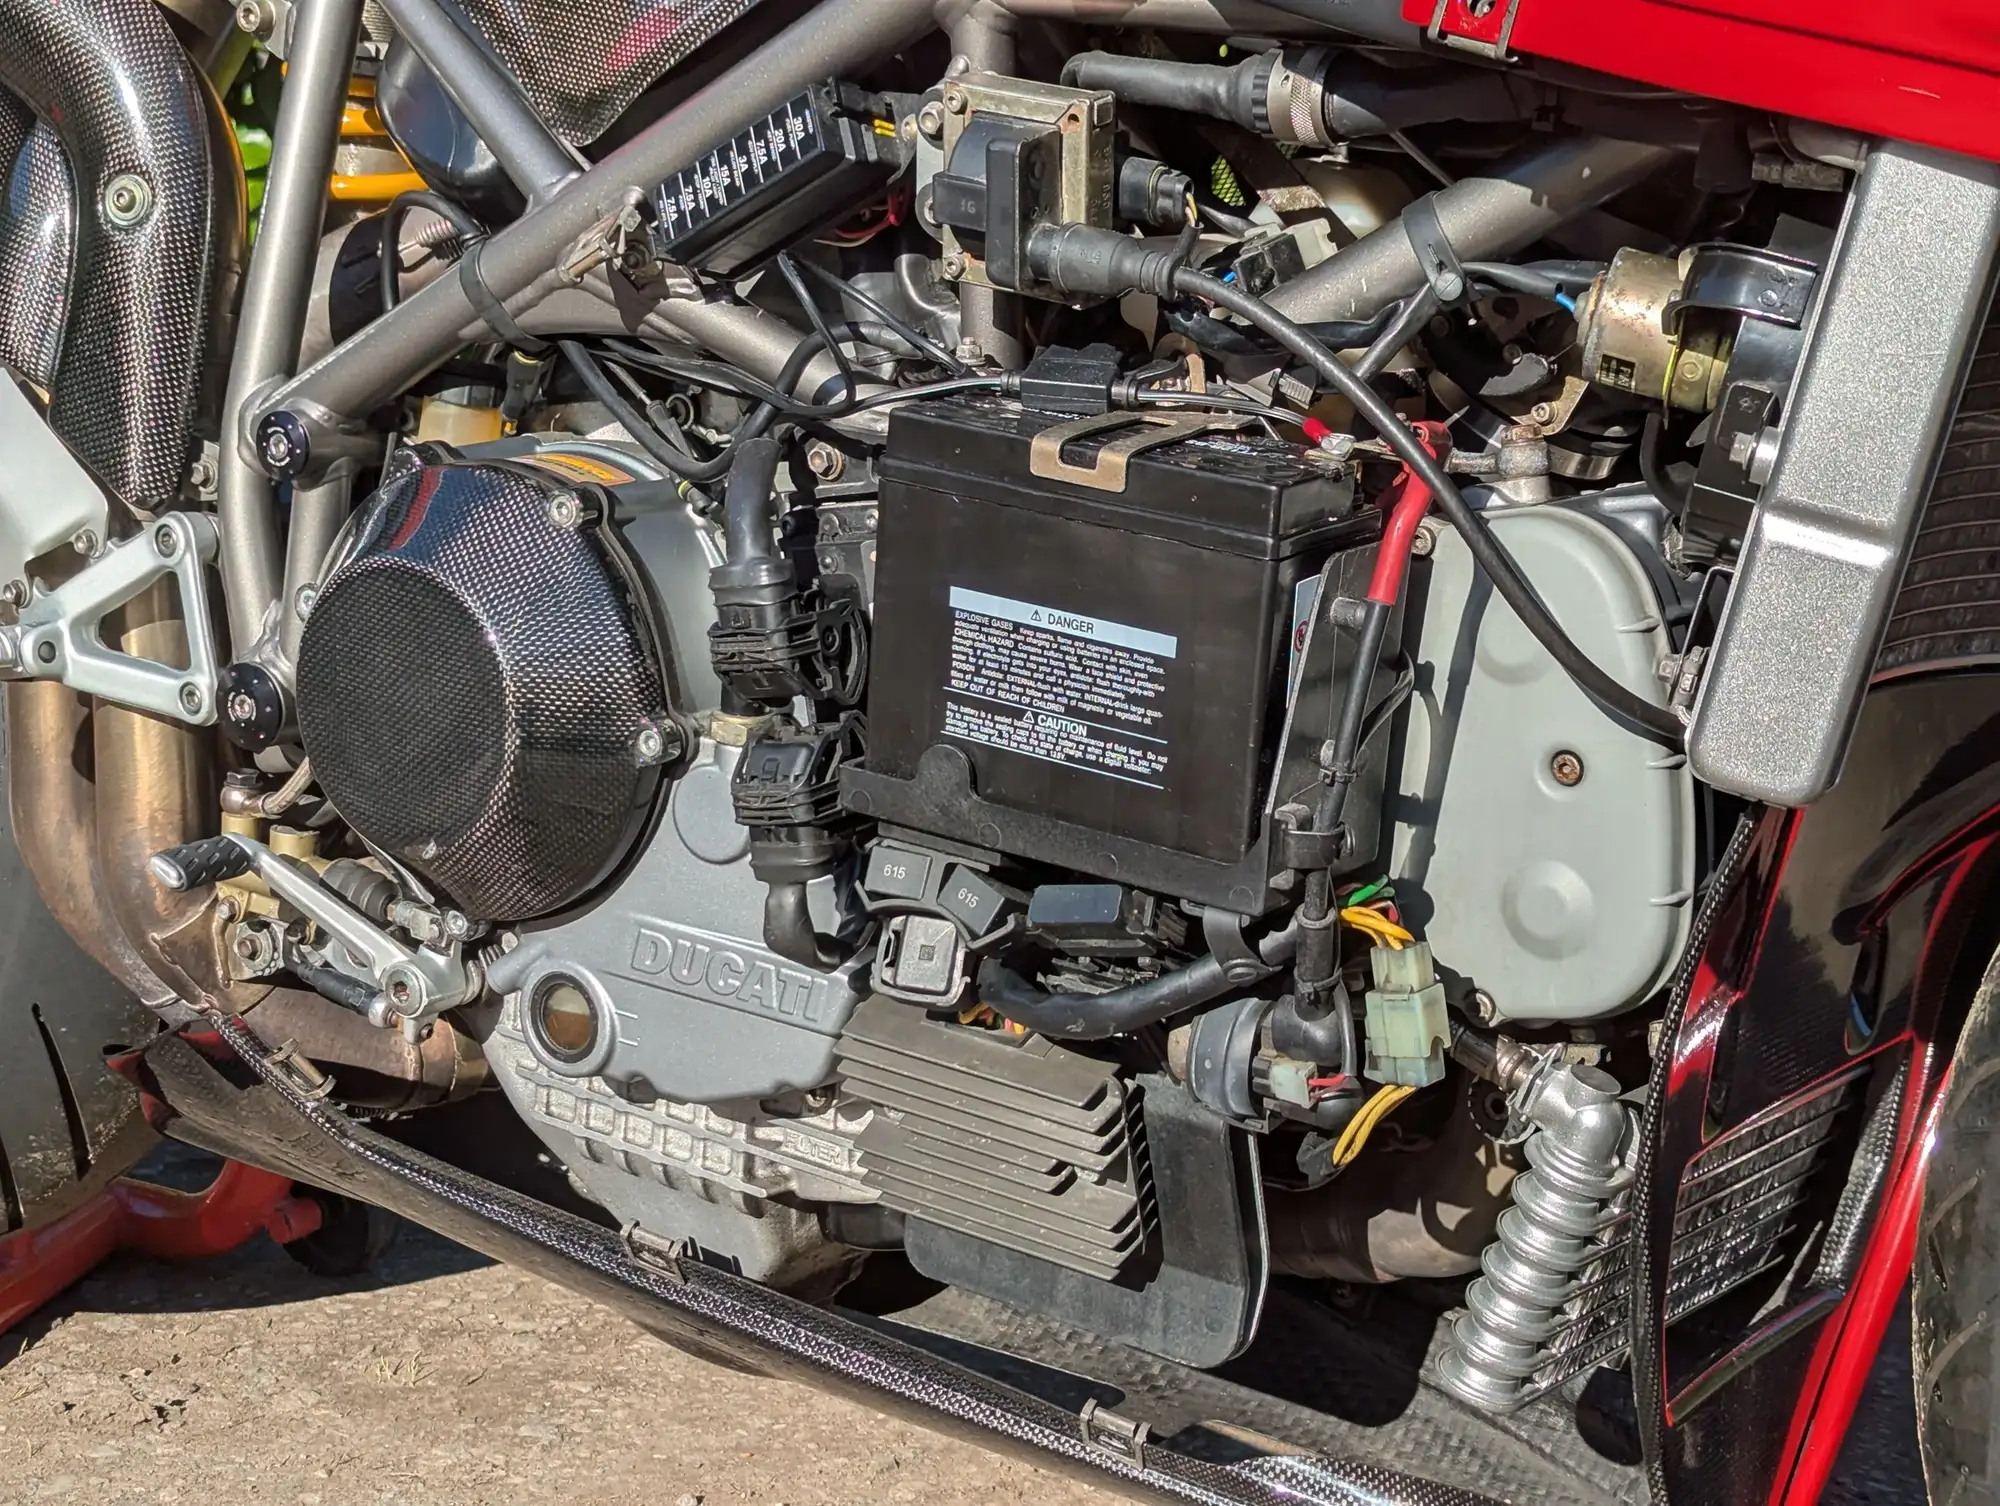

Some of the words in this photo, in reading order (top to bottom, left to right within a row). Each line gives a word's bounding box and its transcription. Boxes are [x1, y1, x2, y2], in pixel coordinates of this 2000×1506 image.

[774, 128, 786, 152] 20A
[793, 116, 805, 140] 30A
[738, 155, 748, 172] 3A
[755, 139, 768, 164] 7.5A
[702, 176, 713, 197] 10A
[720, 164, 731, 186] 15A
[666, 196, 678, 221] 7.5A
[684, 185, 695, 210] 7.5A
[955, 610, 989, 625] EXPLOSIVE
[991, 618, 1013, 630] GASES
[1019, 627, 1034, 636] Keep
[1057, 636, 1072, 645] flame
[1086, 644, 1112, 654] cigarettes
[1133, 653, 1154, 664] Provide
[1047, 613, 1094, 635] DANGER
[954, 620, 979, 630] adequate
[981, 627, 1008, 637] ventilation
[1010, 633, 1024, 641] when
[1026, 637, 1050, 648] charging
[1060, 645, 1075, 654] using
[1076, 648, 1100, 659] batteries
[1119, 659, 1144, 669] enclosed
[954, 627, 987, 642] CHEMICAL
[988, 635, 1014, 648] HAZARD
[1018, 642, 1042, 654] Contains
[1082, 658, 1104, 668] Contact
[1134, 671, 1148, 679] even
[952, 636, 973, 646] through
[998, 647, 1010, 655] may
[1011, 650, 1027, 659] cause
[1029, 655, 1047, 663] severe
[1068, 663, 1083, 671] Wear
[1091, 668, 1104, 677] face
[1105, 672, 1122, 681] shield
[1137, 680, 1165, 691] protective
[982, 652, 1010, 663] electrolyte
[1026, 661, 1037, 669] into
[1096, 678, 1110, 686] flush
[951, 679, 969, 688] KEEP
[969, 683, 984, 692] OUT
[986, 687, 995, 695] OF
[997, 690, 1019, 701] REACH
[1021, 696, 1030, 704] OF
[1032, 698, 1064, 713] CHILDREN
[952, 660, 975, 672] POISON
[1052, 686, 1064, 694] with
[1130, 704, 1145, 714] large
[985, 660, 999, 668] least
[1010, 667, 1031, 676] minutes
[1063, 679, 1090, 690] physician
[1092, 685, 1125, 700] immediately.
[973, 676, 989, 684] water
[998, 682, 1009, 690] milk
[1011, 684, 1024, 693] then
[1025, 687, 1042, 697] follow
[1043, 693, 1055, 701] with
[1056, 696, 1068, 704] milk
[1115, 711, 1142, 722] vegetable
[945, 717, 968, 730] damage
[969, 723, 979, 733] the
[1002, 731, 1009, 741] To
[1010, 733, 1027, 745] check
[1029, 738, 1039, 748] the
[1040, 741, 1054, 752] state
[1053, 745, 1062, 754] of
[1085, 753, 1096, 761] use
[945, 725, 968, 735] standard
[970, 731, 989, 741] voltage
[990, 736, 1008, 745] should
[1010, 740, 1018, 748] be
[1019, 743, 1033, 752] more
[1035, 747, 1047, 755] than
[946, 710, 954, 719] try
[955, 712, 961, 720] to
[963, 715, 983, 727] remove
[984, 719, 994, 729] the
[995, 723, 1014, 734] sealing
[1015, 728, 1029, 738] caps
[1030, 731, 1037, 740] to
[1038, 733, 1046, 743] fill
[1047, 735, 1056, 744] the
[1058, 738, 1076, 750] battery
[1087, 746, 1102, 755] when
[1105, 750, 1128, 763] charging
[1138, 759, 1149, 768] you
[1151, 762, 1164, 772] may
[947, 702, 958, 711] This
[960, 706, 979, 717] battery
[994, 715, 1012, 724] sealed
[1013, 719, 1032, 730] battery
[1034, 725, 1058, 737] requiring
[1069, 734, 1104, 747] maintenance
[1106, 743, 1113, 751] of
[1147, 752, 1156, 760] Do
[1037, 714, 1088, 738] CAUTION
[883, 864, 906, 880] 615
[958, 887, 979, 908] 615
[631, 928, 829, 1023] DUCATI
